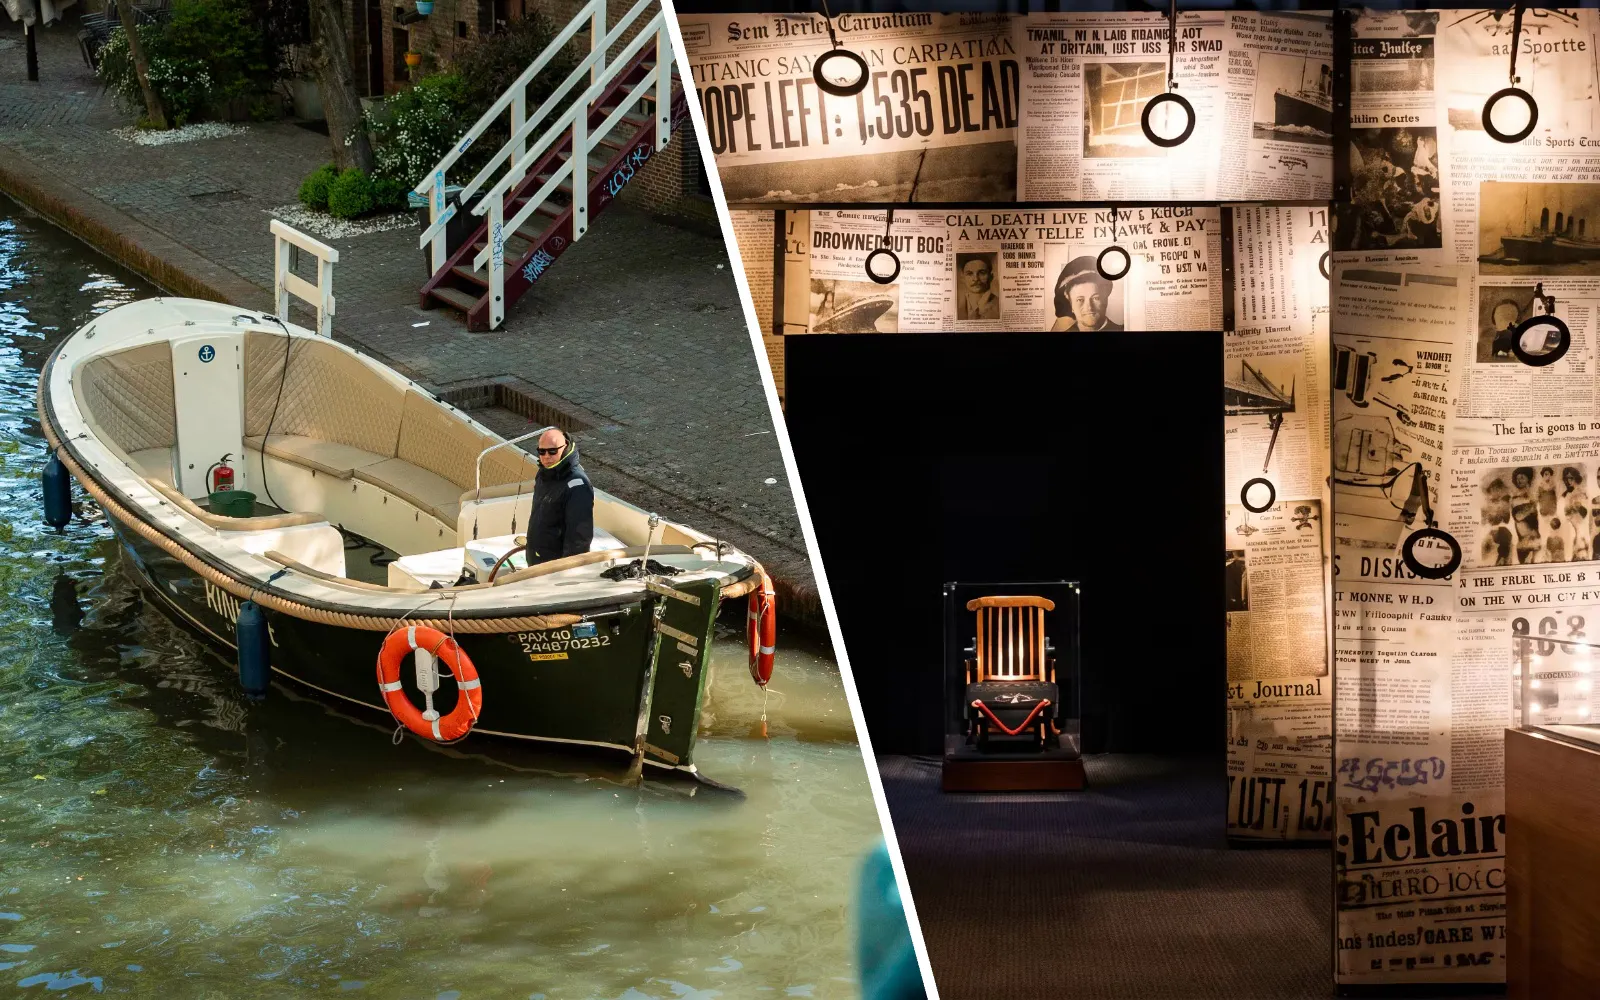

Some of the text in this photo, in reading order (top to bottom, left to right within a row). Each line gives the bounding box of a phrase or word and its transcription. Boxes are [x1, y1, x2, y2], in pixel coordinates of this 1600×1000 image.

[1040, 43, 1055, 55] AT
[938, 59, 1020, 136] DEAD
[946, 214, 984, 227] CIAL
[991, 213, 1045, 226] DEATH
[1052, 212, 1088, 225] LIVE
[958, 229, 970, 241] A
[1035, 227, 1085, 240] TELLE
[1175, 218, 1207, 232] PAY
[917, 236, 944, 253] BOG
[1492, 423, 1516, 436] The
[1473, 577, 1495, 587] THE
[1482, 595, 1506, 606] THE
[518, 629, 571, 643] PAX 40
[521, 635, 611, 653] 244870232
[1253, 678, 1322, 699] Journal
